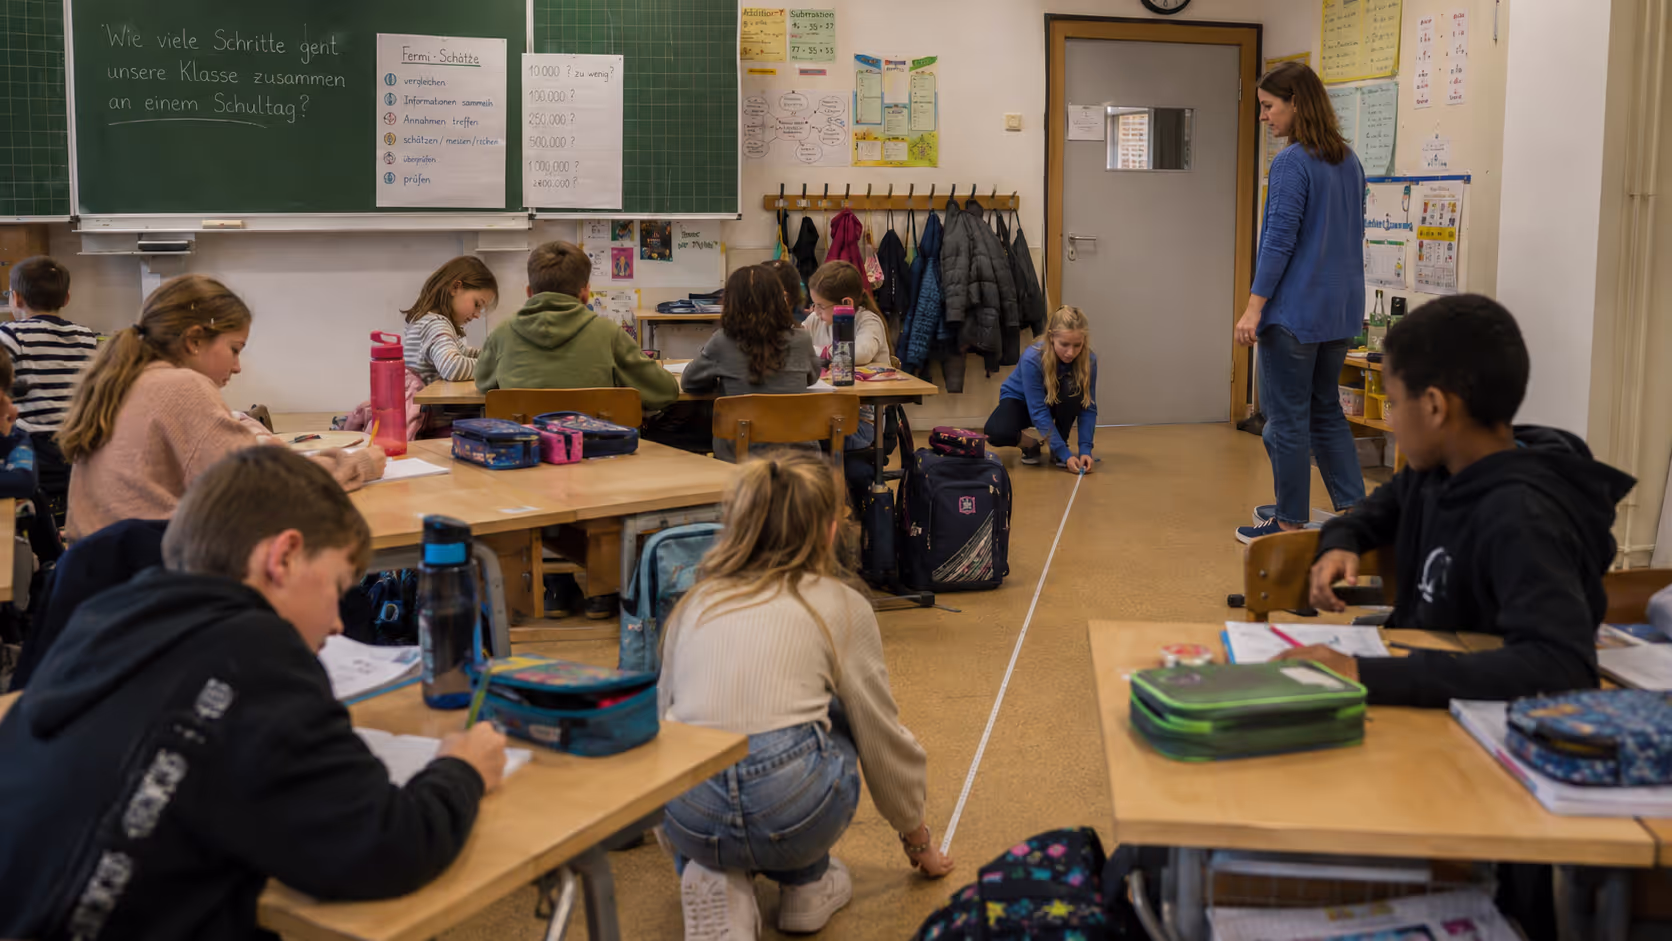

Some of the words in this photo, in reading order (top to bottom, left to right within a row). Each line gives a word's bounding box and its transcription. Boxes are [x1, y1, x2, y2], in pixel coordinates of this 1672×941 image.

[105, 24, 143, 48] Wie
[157, 28, 199, 51] viele
[214, 29, 286, 54] Schritte
[402, 45, 430, 62] Fermi
[107, 64, 167, 81] unsere
[179, 59, 240, 84] Klasse
[253, 72, 346, 88] zusammen
[574, 70, 585, 78] zu
[403, 76, 446, 88] vergleichen
[108, 95, 132, 111] an
[144, 95, 198, 113] einem
[213, 92, 310, 124] Schultag?
[403, 94, 457, 108] Informationen
[403, 114, 446, 125] Annahmen
[452, 116, 479, 128] treffen
[403, 173, 431, 187] prüfen
